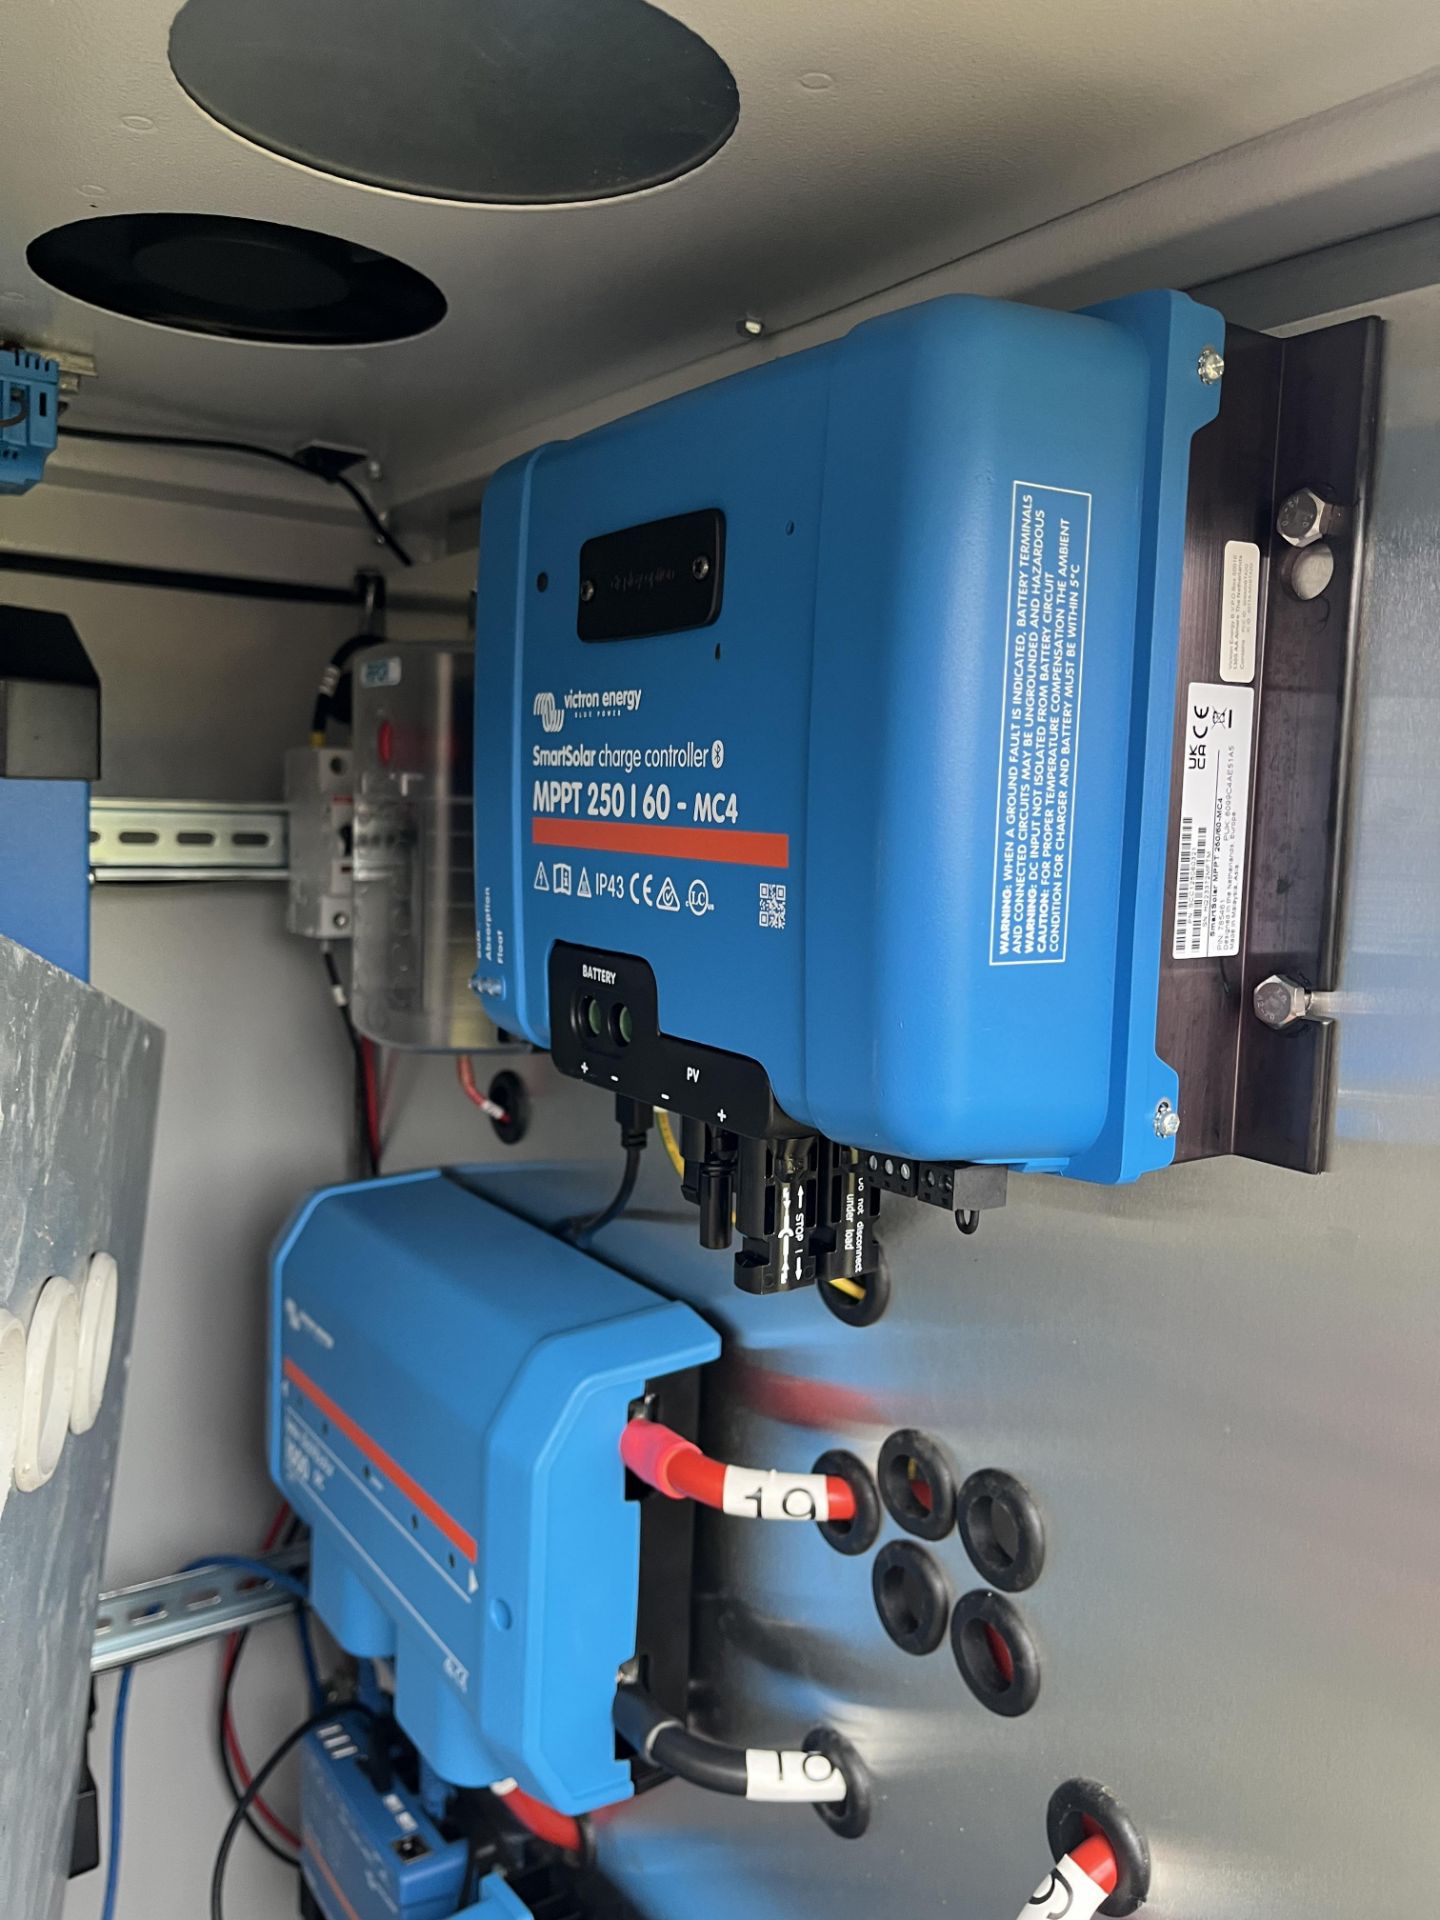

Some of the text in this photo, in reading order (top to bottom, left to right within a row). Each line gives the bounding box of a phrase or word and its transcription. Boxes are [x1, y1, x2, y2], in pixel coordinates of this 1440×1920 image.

[1067, 591, 1078, 638] WITHIN
[1067, 642, 1076, 657] BE
[564, 688, 642, 711] victron energy
[1064, 661, 1075, 698] MUST
[596, 709, 622, 718] POWER
[1000, 494, 1033, 954] WARNING: WHEN A GROUND FAULT IS INDICATED, BATTERY TERMINALS
[1012, 510, 1045, 953] AND CONNECTED CIRCUITS MAY BE UNGROUNDED AND HAZARDOUS
[1037, 518, 1070, 953] CAUTION: FOR PROPER TEMPERATURE COMPENSATION THE AMBIENT
[1061, 703, 1073, 754] BATTERY
[532, 741, 709, 774] SmartSolar charge controller
[1024, 572, 1054, 953] WARNING: DC INPUT NOT ISOLATED FROM BATTERY CIRCUIT
[1058, 758, 1069, 787] AND
[533, 780, 582, 814] MPPT
[587, 782, 625, 818] 250
[642, 783, 671, 820] 60
[693, 792, 738, 824] MC4
[1055, 790, 1067, 850] CHARGER
[595, 872, 624, 899] IP43
[1053, 854, 1064, 878] FOR
[1212, 855, 1220, 882] MPPT
[1223, 914, 1231, 950] Designed
[1229, 812, 1237, 839] Europe
[484, 887, 493, 961] Absorption
[1049, 881, 1062, 952] CONDITION
[1210, 884, 1219, 937] SmartSolar
[496, 929, 504, 965] Float
[582, 964, 616, 985] BATTERY
[686, 1066, 700, 1083] PV
[795, 1213, 804, 1242] STOP
[844, 1193, 855, 1251] under load
[855, 1221, 864, 1273] disconnect
